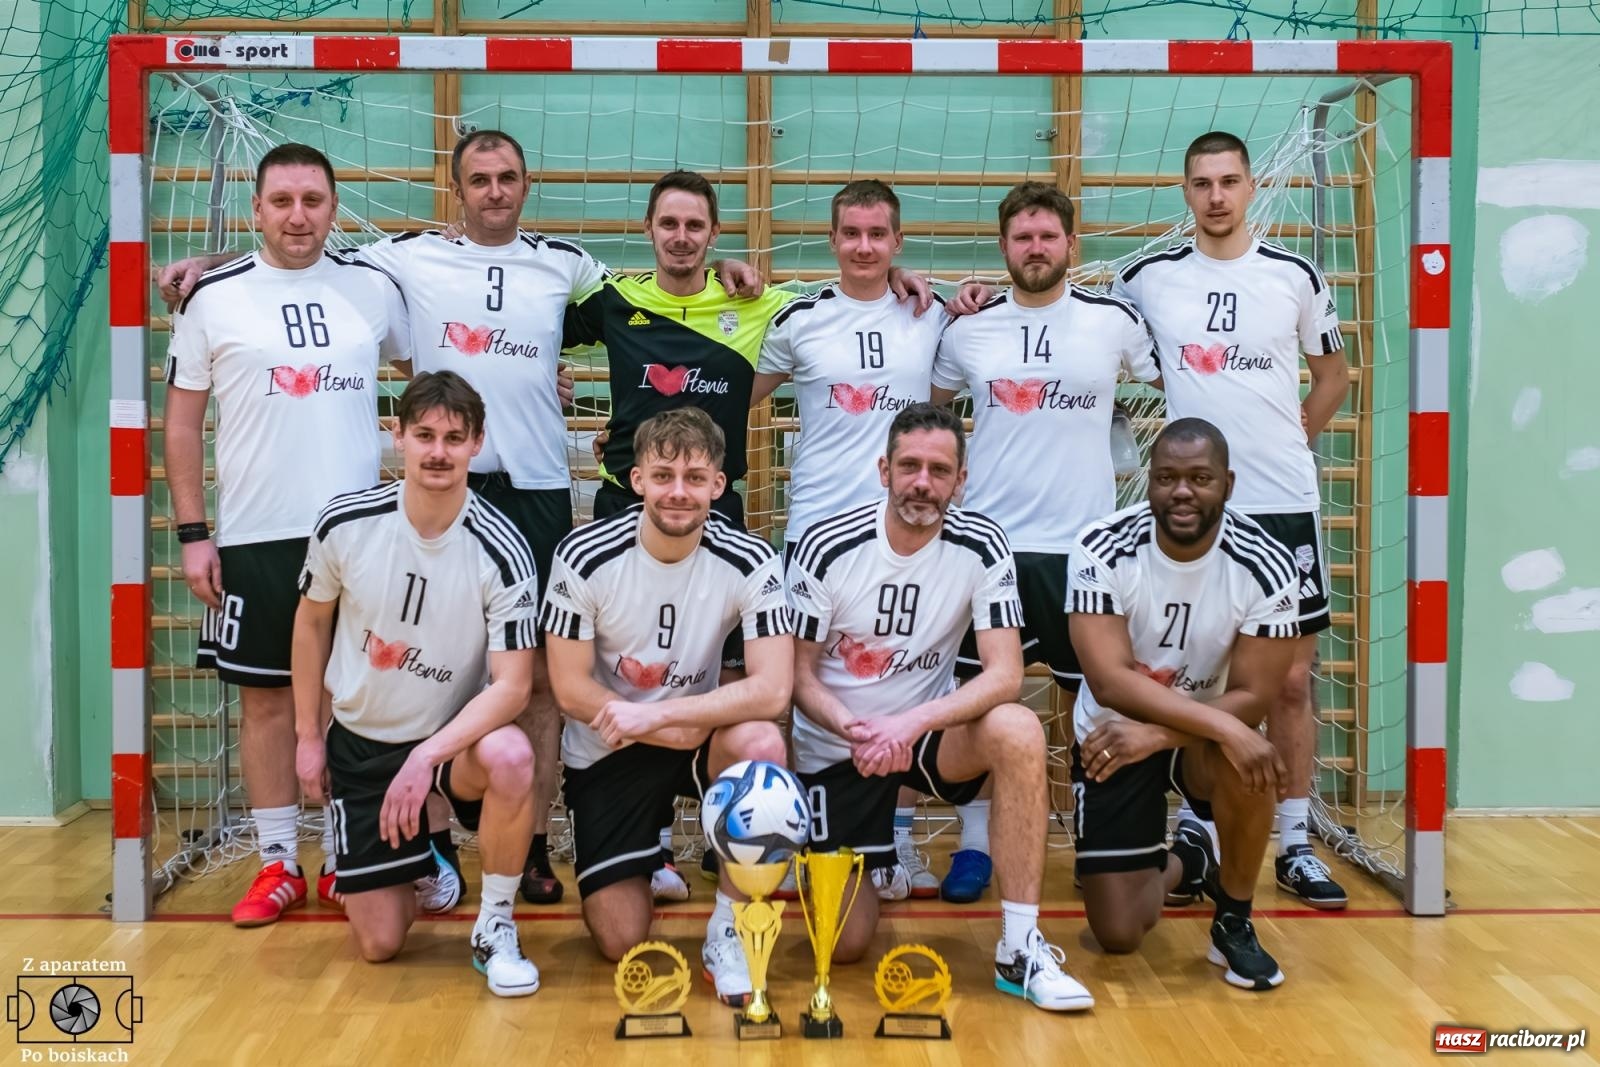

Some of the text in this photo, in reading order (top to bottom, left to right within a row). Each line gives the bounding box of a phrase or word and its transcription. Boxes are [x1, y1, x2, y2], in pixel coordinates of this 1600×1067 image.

[236, 43, 288, 61] sport
[485, 265, 505, 312] 3
[281, 302, 330, 348] 86
[1206, 291, 1237, 333] 23
[855, 331, 885, 370] 19
[1020, 324, 1052, 364] 14
[399, 572, 428, 626] 11
[873, 583, 921, 637] 99
[657, 603, 676, 649] 9
[1158, 602, 1192, 651] 21
